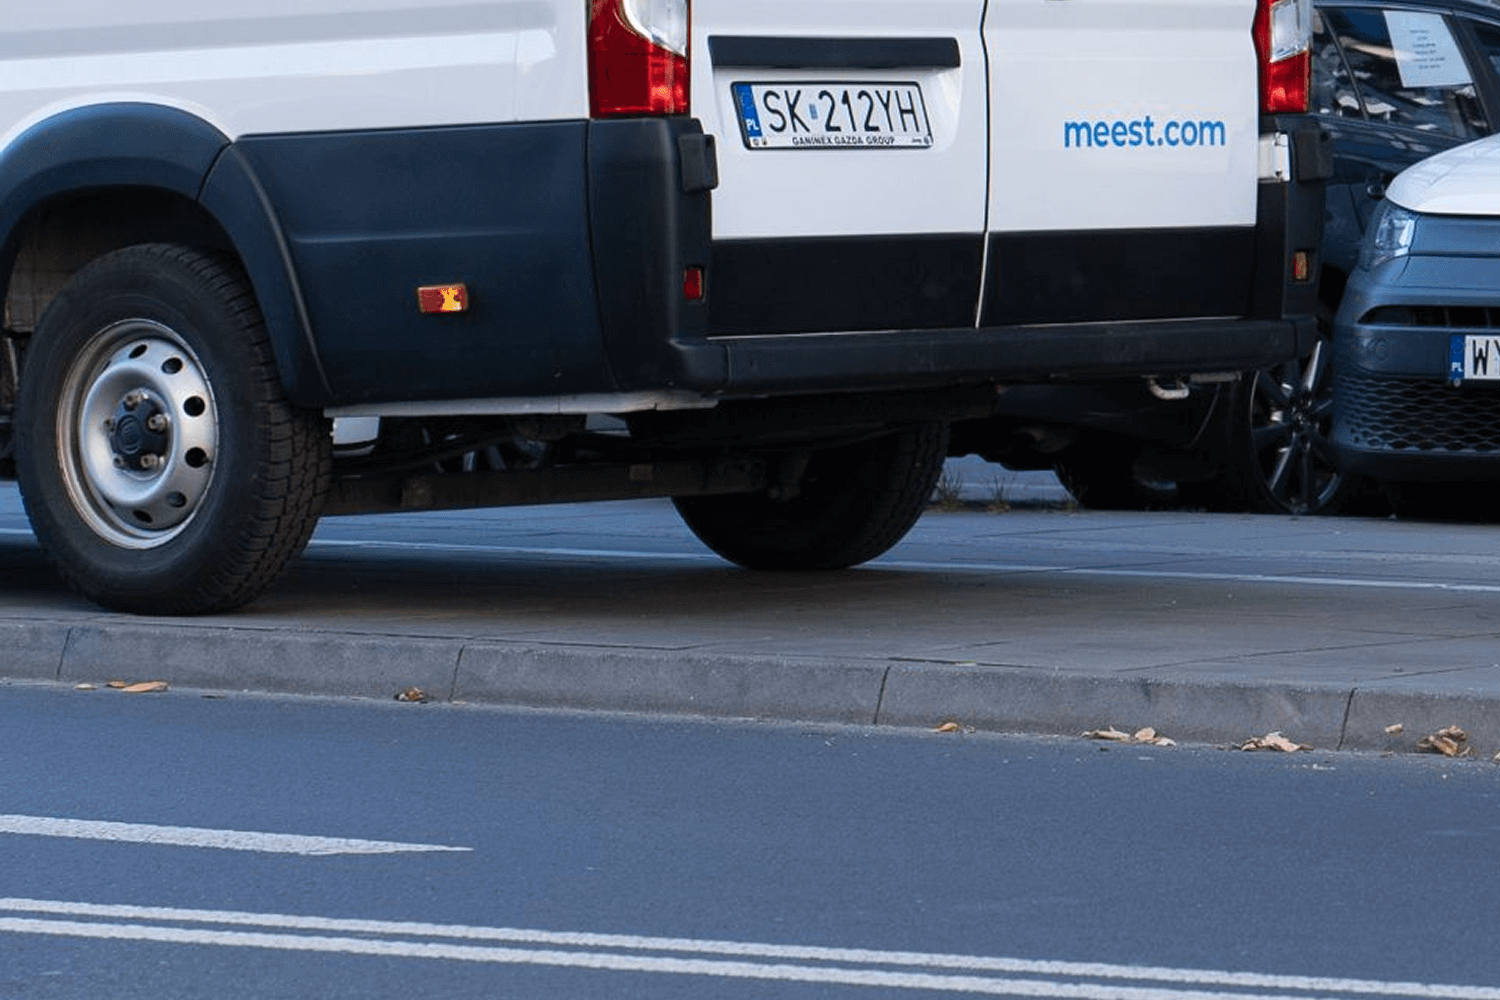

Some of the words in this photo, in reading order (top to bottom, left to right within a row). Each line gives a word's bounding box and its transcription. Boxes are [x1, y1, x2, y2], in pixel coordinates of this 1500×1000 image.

[763, 90, 810, 133] SK
[818, 90, 920, 133] 212YH
[746, 118, 760, 131] PL
[1064, 115, 1226, 147] meest.com
[865, 135, 895, 145] GROUP
[1452, 361, 1464, 373] PL
